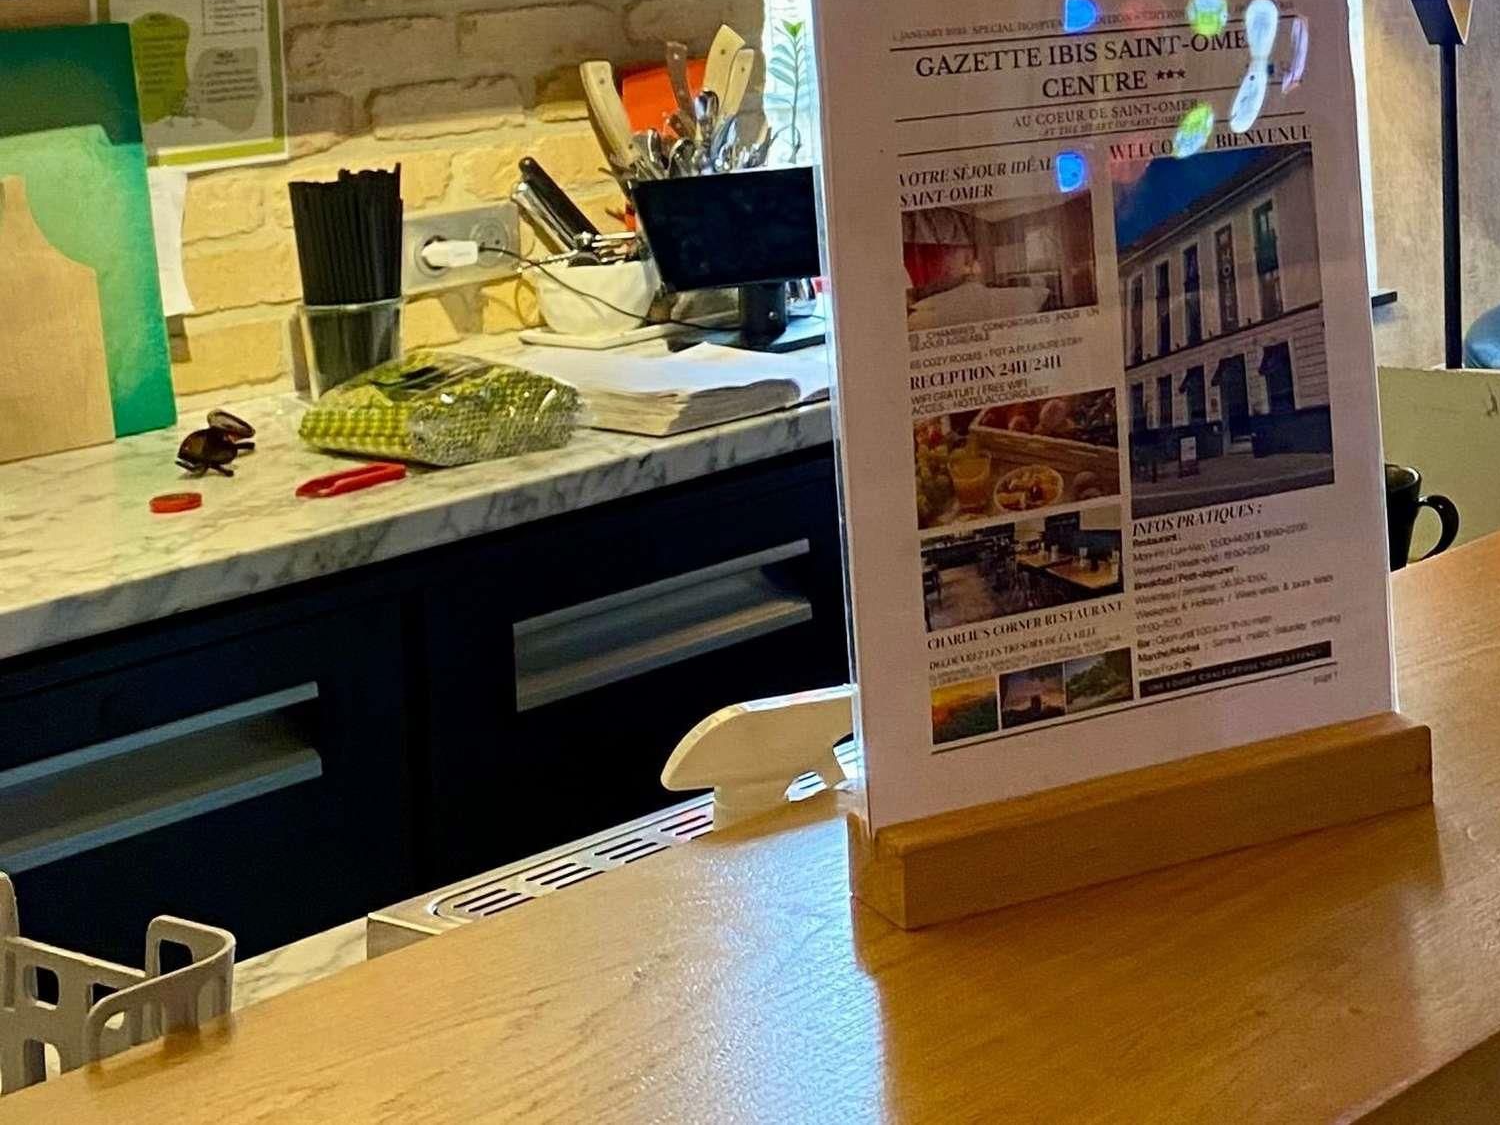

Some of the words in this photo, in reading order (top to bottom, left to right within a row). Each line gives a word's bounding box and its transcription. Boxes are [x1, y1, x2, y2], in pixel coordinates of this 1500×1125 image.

[916, 46, 1042, 77] GAZETTE
[1049, 42, 1098, 66] IBIS
[1105, 31, 1253, 60] SAINT-OME
[1042, 70, 1148, 99] CENTRE
[1013, 117, 1033, 128] AU
[1036, 111, 1084, 126] COEUR
[1089, 108, 1107, 120] DE
[1112, 99, 1199, 117] SAINT-OMER
[1109, 139, 1174, 160] WELCO
[1215, 125, 1313, 148] BIENVENUE
[899, 168, 949, 187] VOTRE
[951, 161, 1007, 181] SÉJOUR
[900, 184, 994, 207] SAINT-OMER
[910, 364, 996, 391] RECEPTION
[933, 387, 975, 403] GRATUIT
[1132, 518, 1175, 537] INFOS
[1175, 504, 1255, 527] PRATIQUES
[993, 616, 1042, 637] CORNER
[1045, 600, 1123, 626] RESTAURANT
